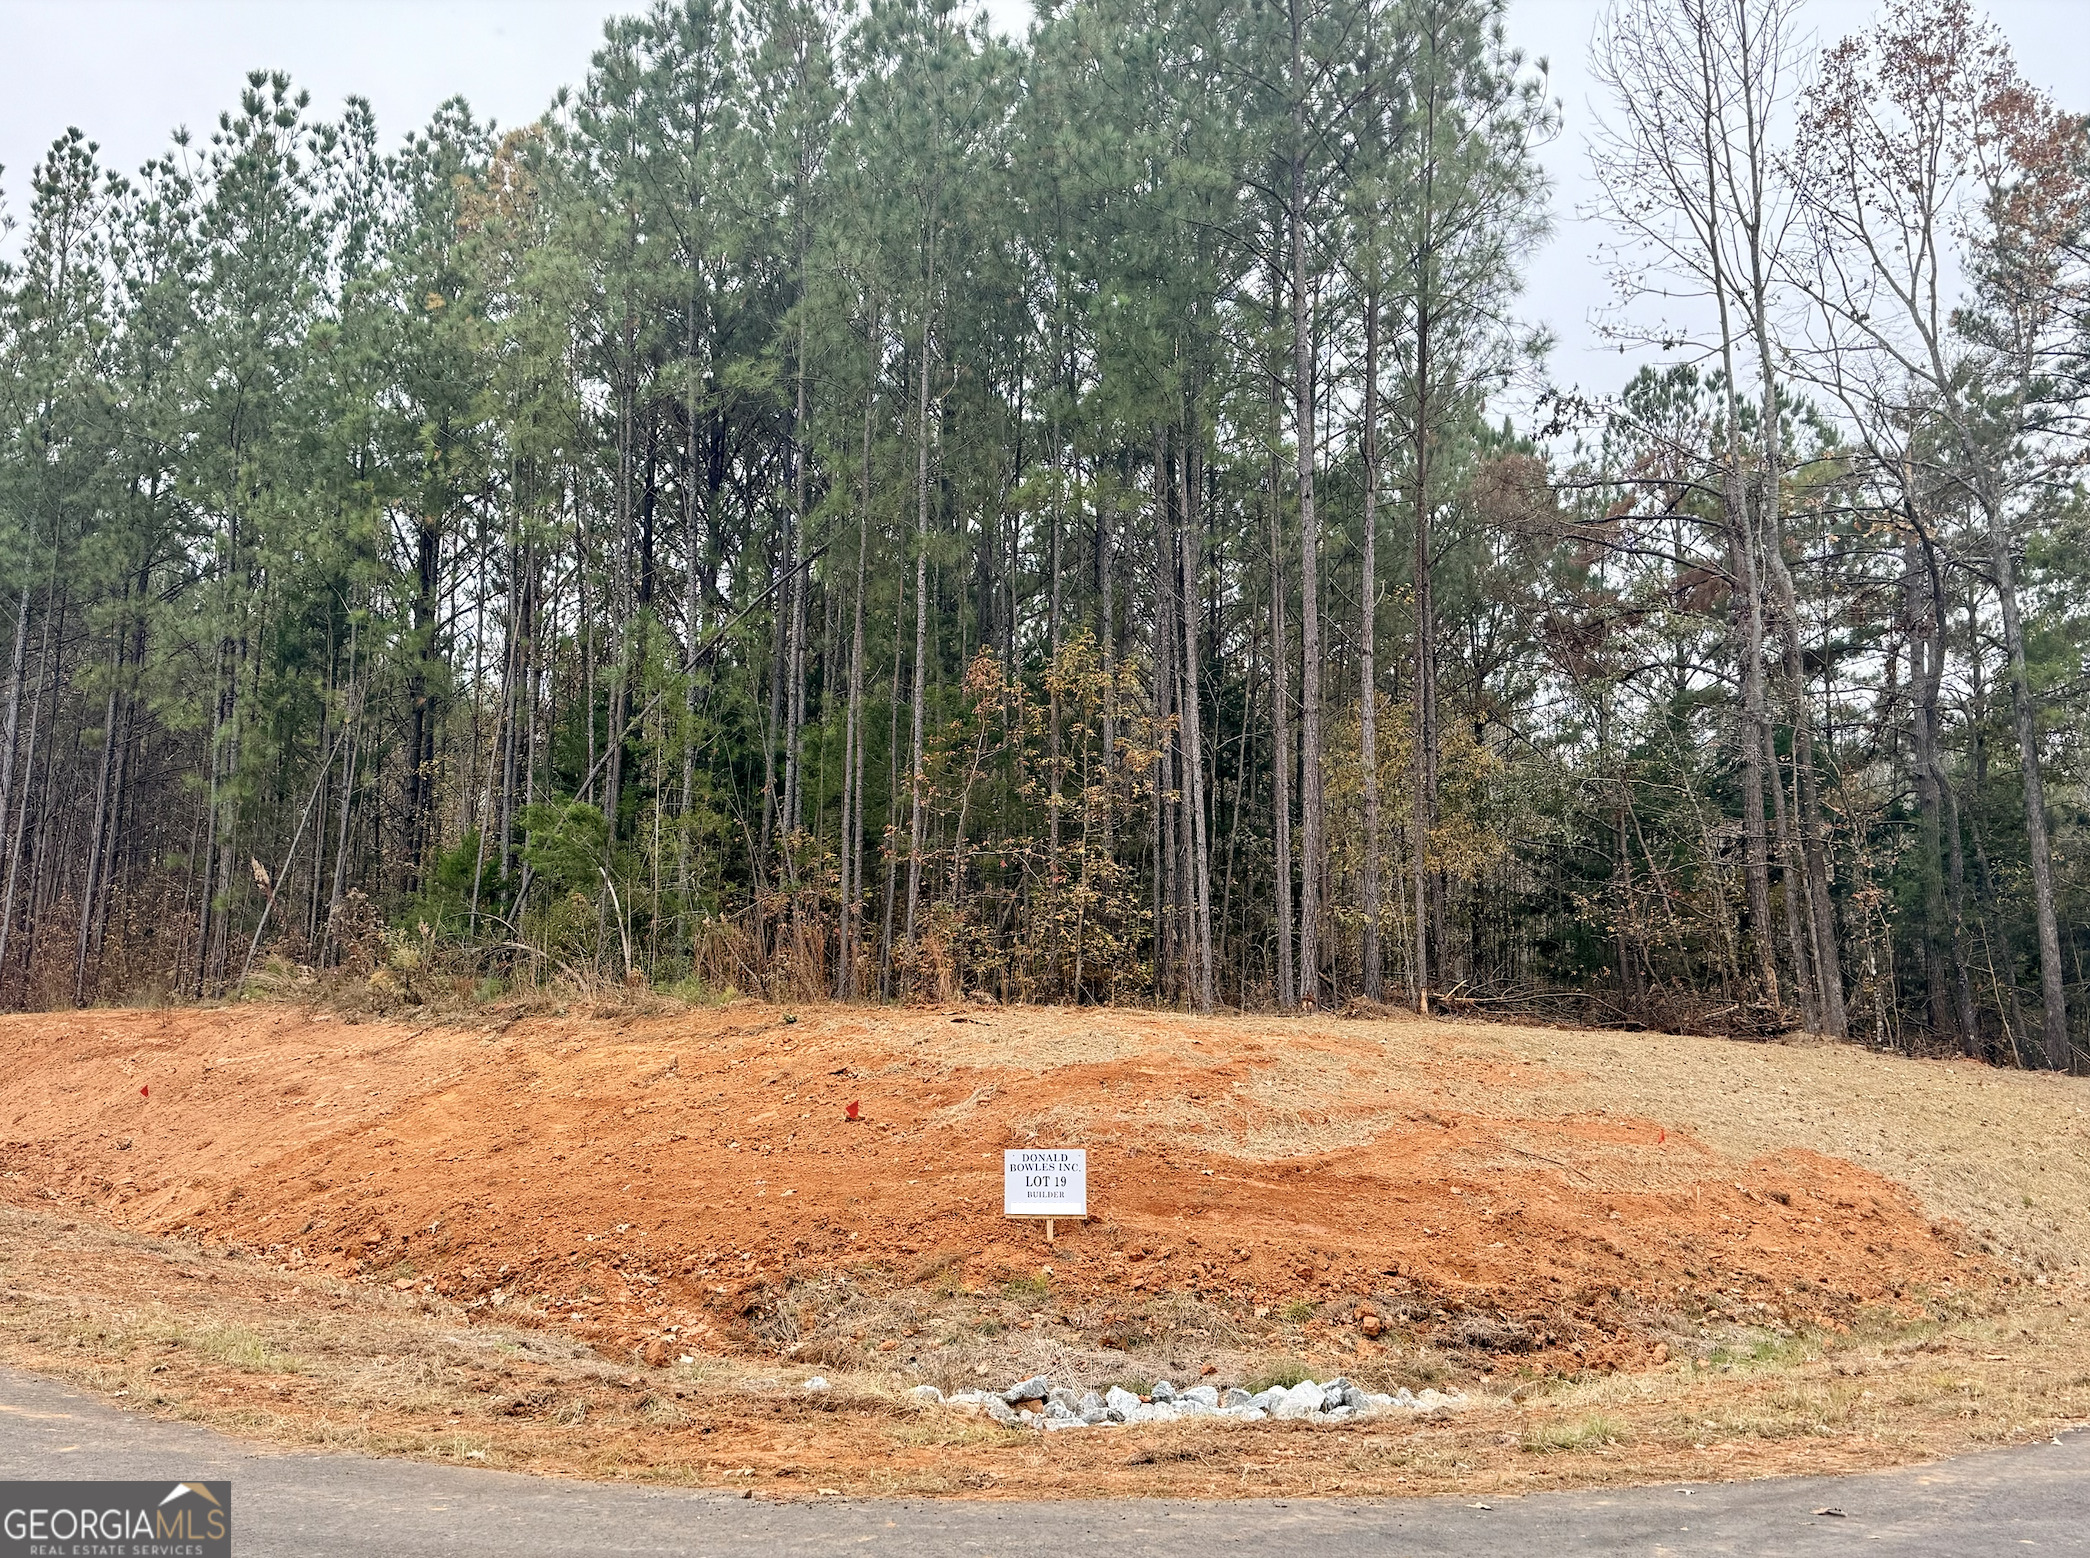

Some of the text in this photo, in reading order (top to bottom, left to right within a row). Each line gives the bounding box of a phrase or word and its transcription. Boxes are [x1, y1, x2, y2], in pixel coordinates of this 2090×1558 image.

[1022, 1153, 1068, 1162] DONALD
[1010, 1163, 1081, 1172] BOWLES INC.
[1025, 1175, 1067, 1187] LOT 19
